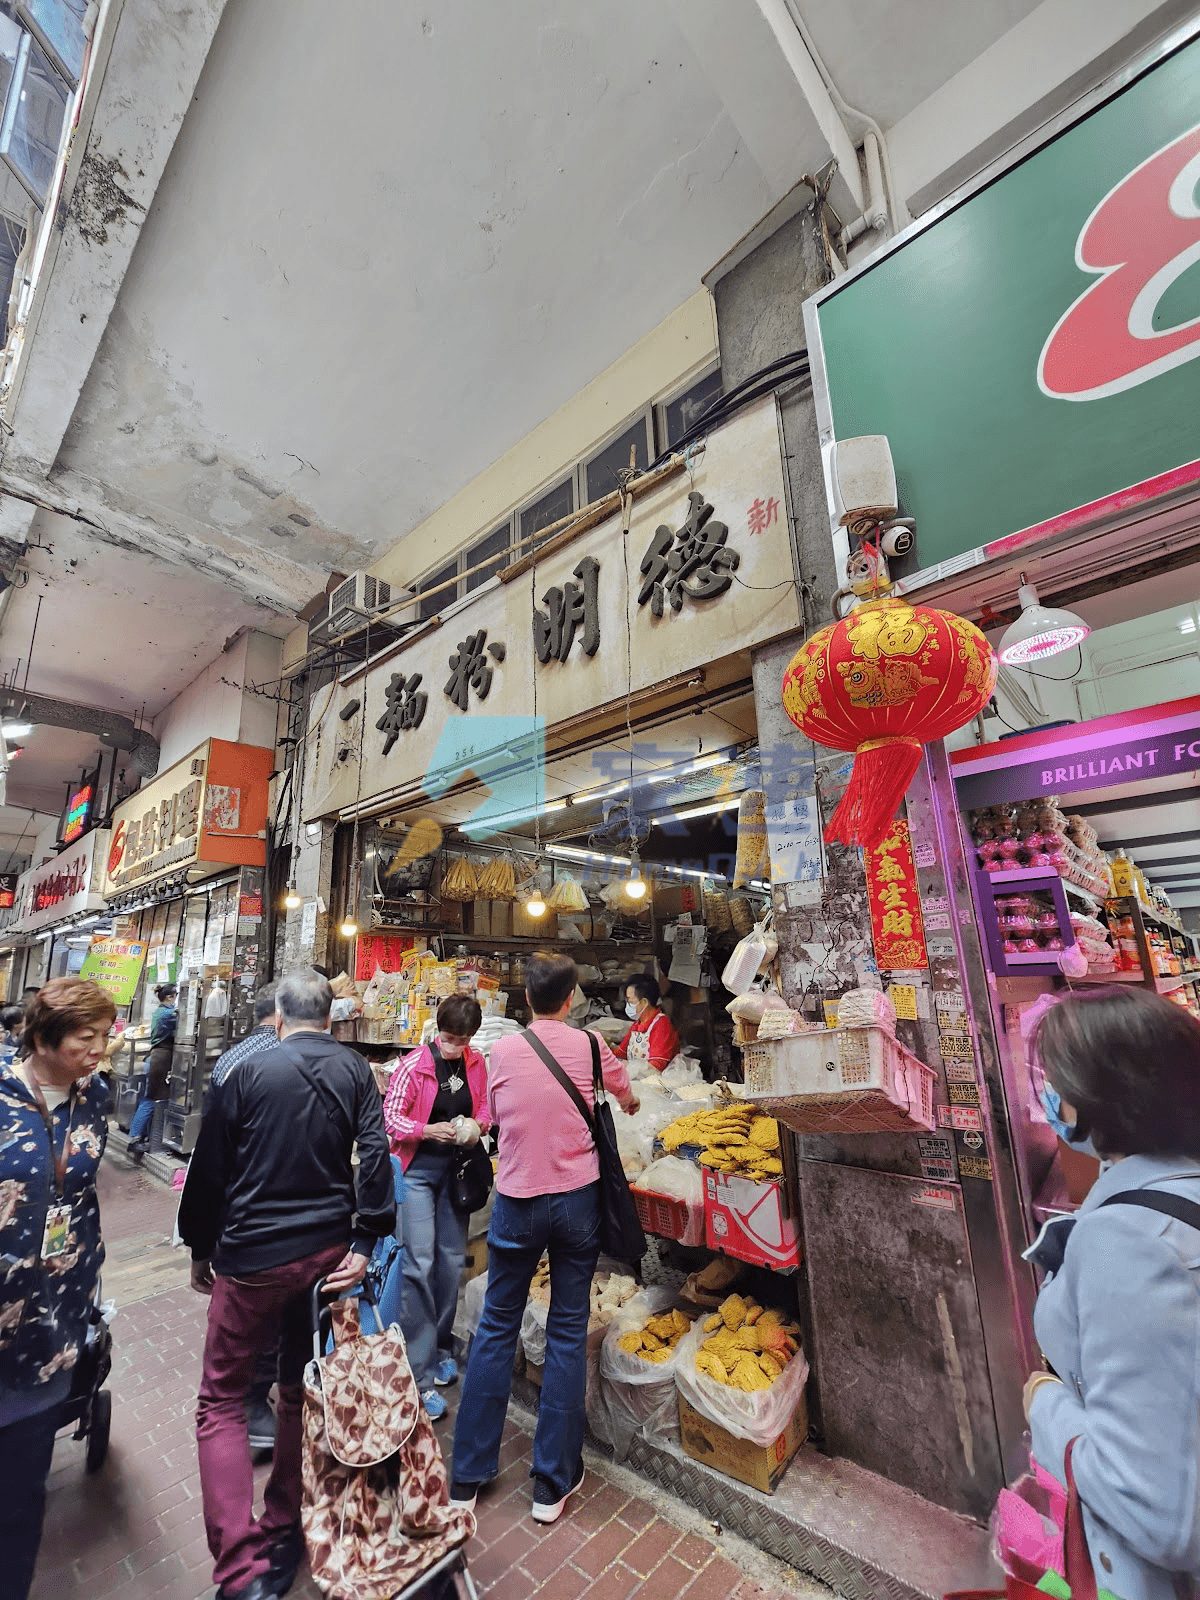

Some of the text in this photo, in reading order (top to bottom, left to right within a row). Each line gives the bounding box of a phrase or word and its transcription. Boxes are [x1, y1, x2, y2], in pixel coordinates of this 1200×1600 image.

[748, 497, 779, 536] 新
[847, 607, 929, 660] 福
[1041, 748, 1160, 786] BRILLIANT
